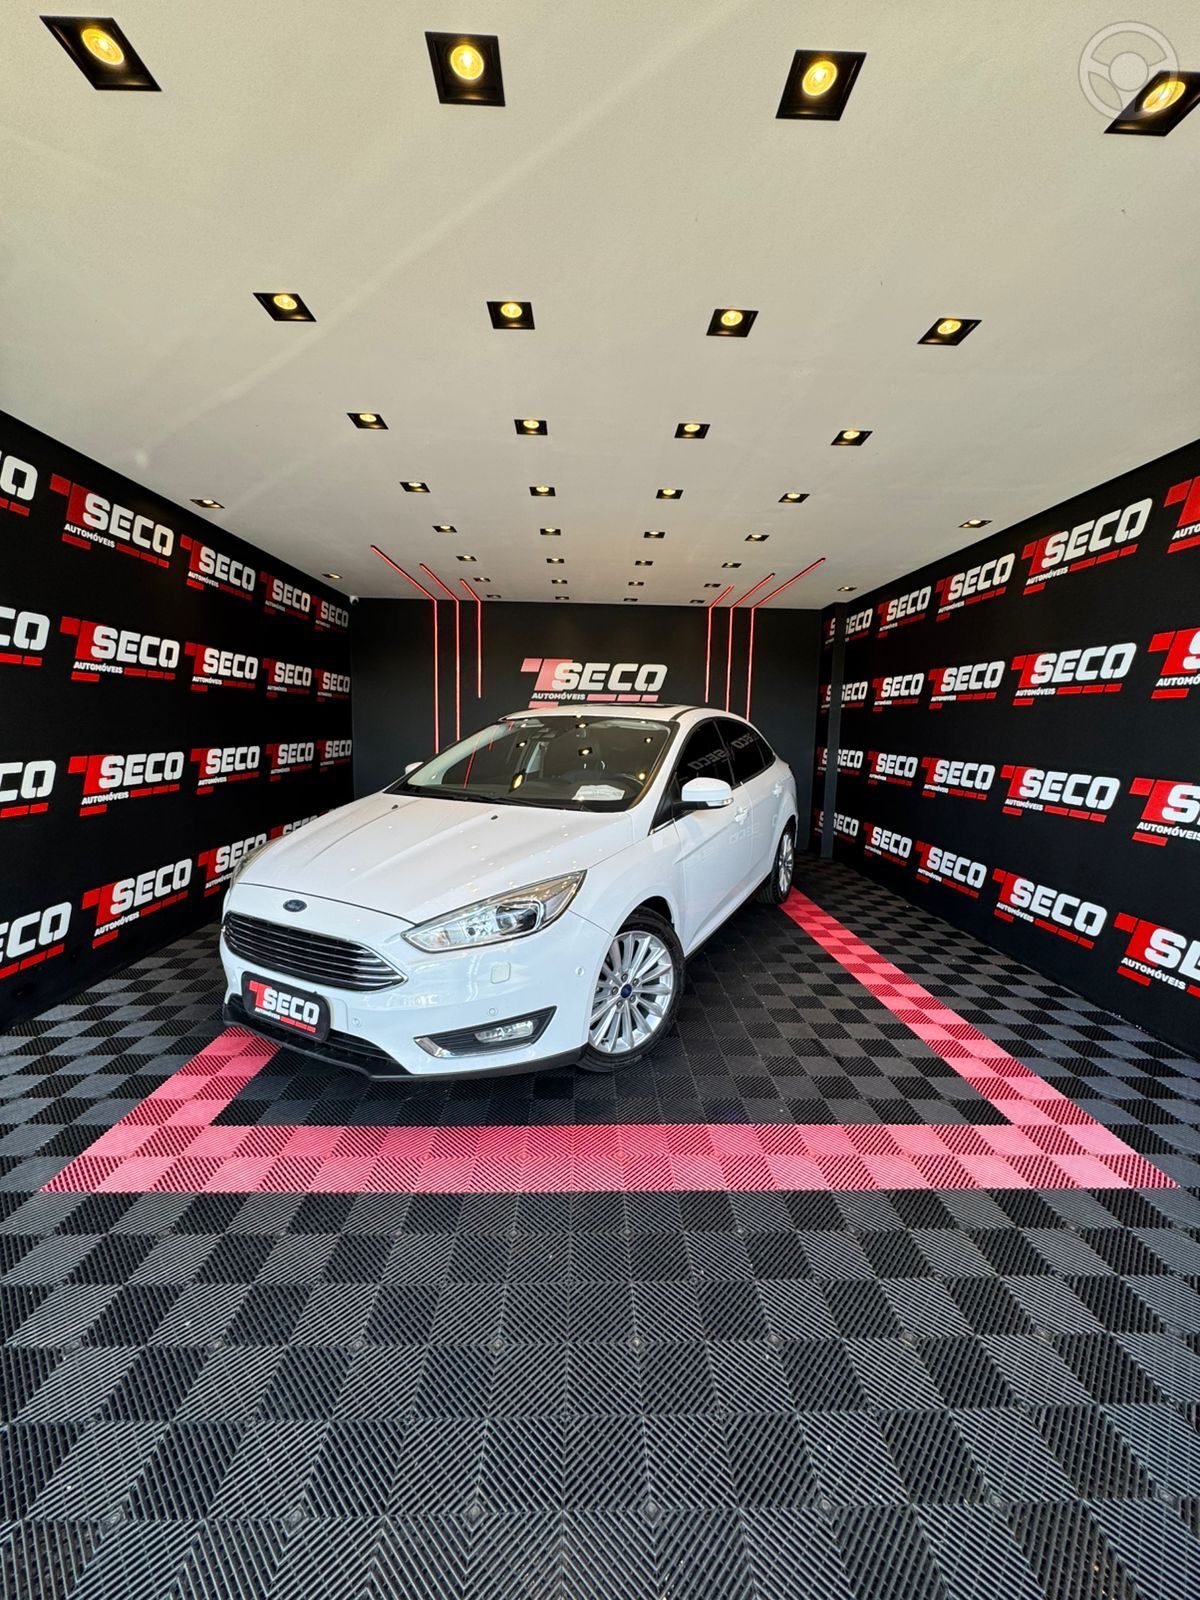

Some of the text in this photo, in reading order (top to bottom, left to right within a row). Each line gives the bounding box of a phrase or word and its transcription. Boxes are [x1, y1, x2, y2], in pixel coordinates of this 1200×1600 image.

[64, 523, 115, 548] AUTOMÓVEIS
[1026, 566, 1068, 585] AUTOMÓVEIS
[73, 661, 123, 674] AUTOMÓVEIS
[531, 692, 585, 702] AUTOMÓVEIS
[1015, 687, 1056, 697] AUTOMÓVEIS
[81, 791, 129, 805] AUTOMÓVEIS
[1005, 798, 1043, 812] AUTOMÓVEIS
[996, 902, 1034, 923] AUTOMÓVEIS
[94, 911, 140, 937] AUTOMÓVEIS
[1121, 957, 1186, 990] AUTOMÓVEIS
